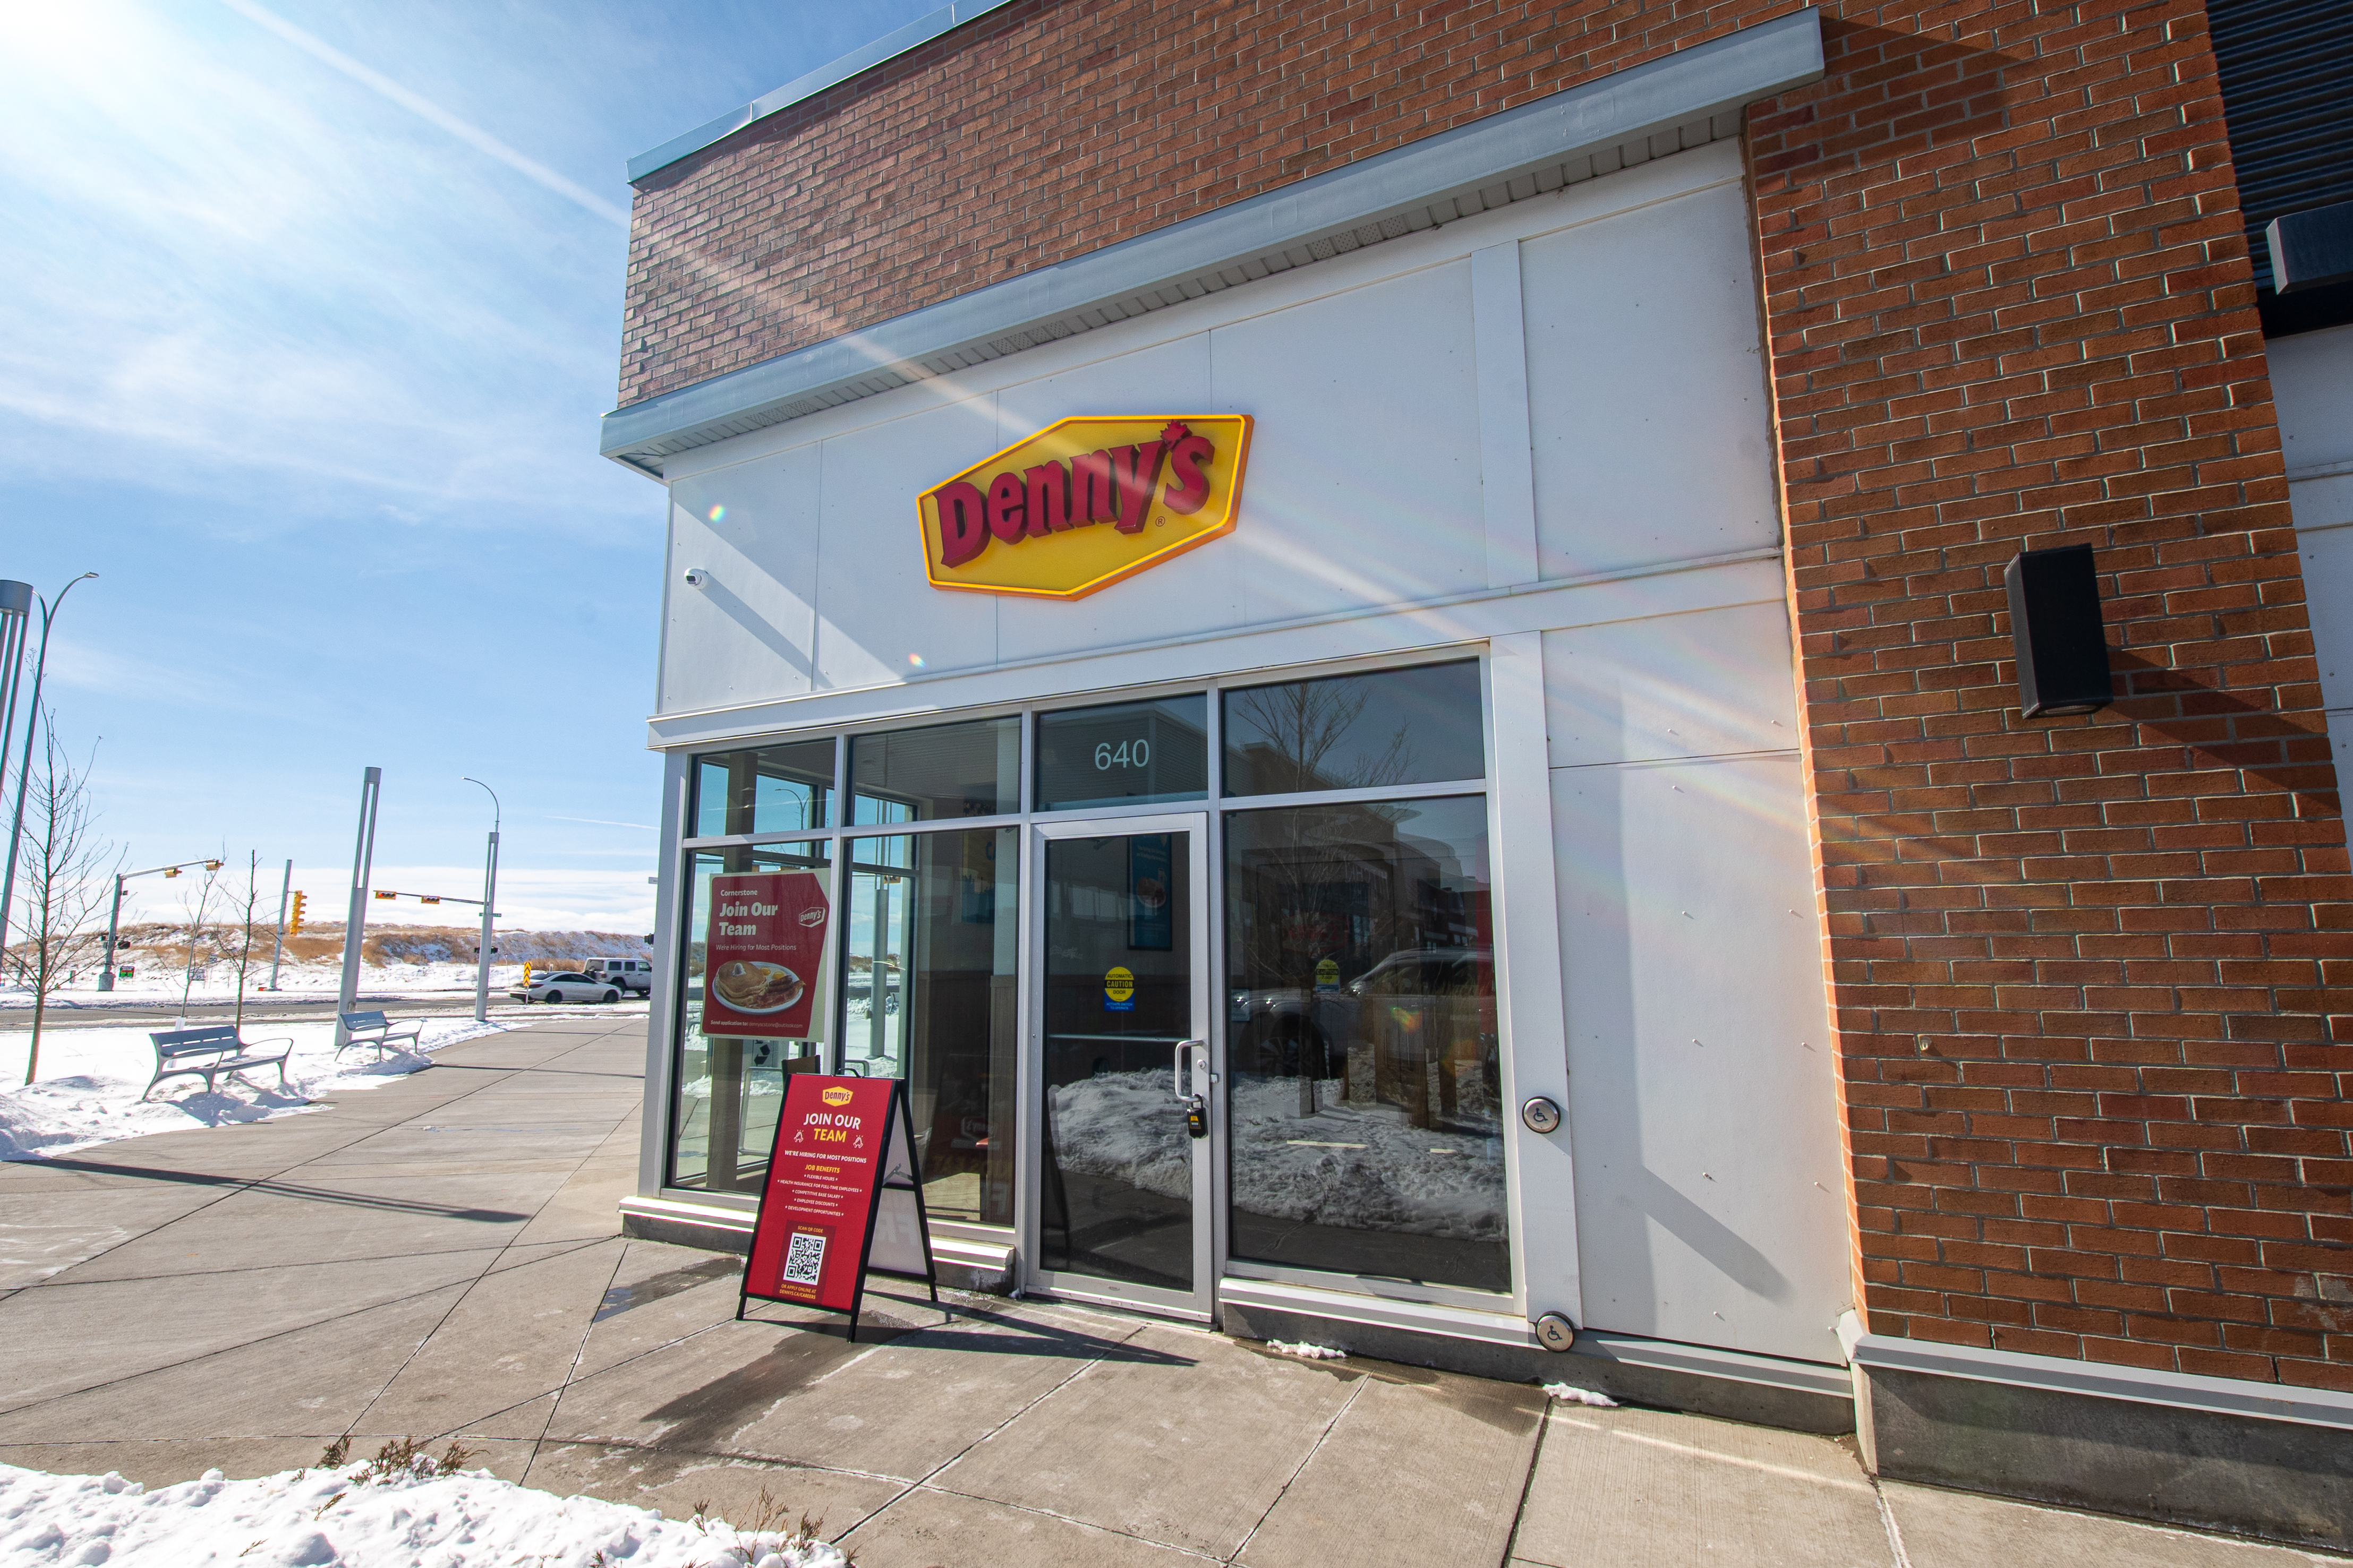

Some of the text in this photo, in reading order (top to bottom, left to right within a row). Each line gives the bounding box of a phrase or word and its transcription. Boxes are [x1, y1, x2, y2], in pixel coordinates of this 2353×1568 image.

[933, 419, 1215, 568] Denny's
[1095, 739, 1149, 770] 640
[719, 901, 778, 917] Join Our
[800, 910, 822, 922] Denny's
[719, 922, 756, 936] Team
[824, 1091, 850, 1102] Denny's
[803, 1113, 861, 1130] JOIN OUR
[814, 1128, 847, 1143] TEAM
[816, 1165, 840, 1173] BENEFITS
